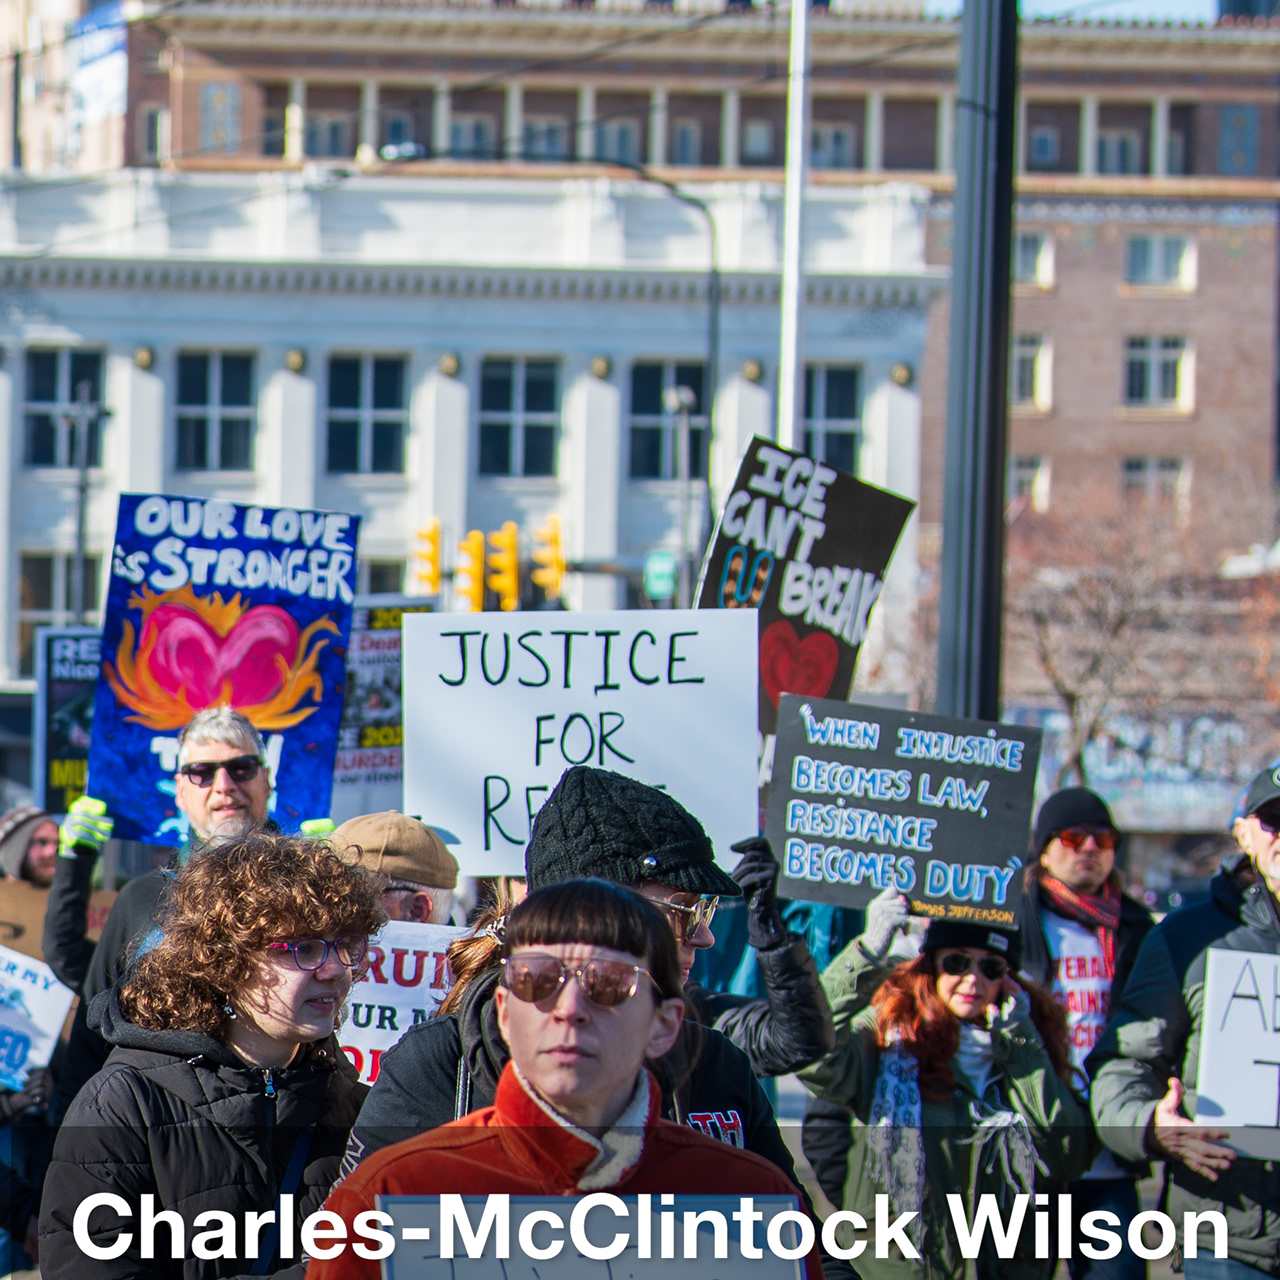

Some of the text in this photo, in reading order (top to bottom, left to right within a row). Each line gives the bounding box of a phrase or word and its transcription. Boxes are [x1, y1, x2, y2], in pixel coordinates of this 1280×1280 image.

[748, 445, 837, 519] ICE
[134, 496, 355, 552] OUR LOVE
[148, 537, 355, 604] STRONGER
[779, 561, 885, 647] BREAK
[439, 629, 705, 697] JUSTICE
[535, 711, 636, 767] FOR
[791, 755, 912, 801] BECOMES
[917, 772, 990, 819] LAW,
[783, 837, 917, 893] BECOMES
[947, 903, 1015, 924] JEFFERSON
[22, 968, 58, 992] MY
[686, 1110, 745, 1150] TH
